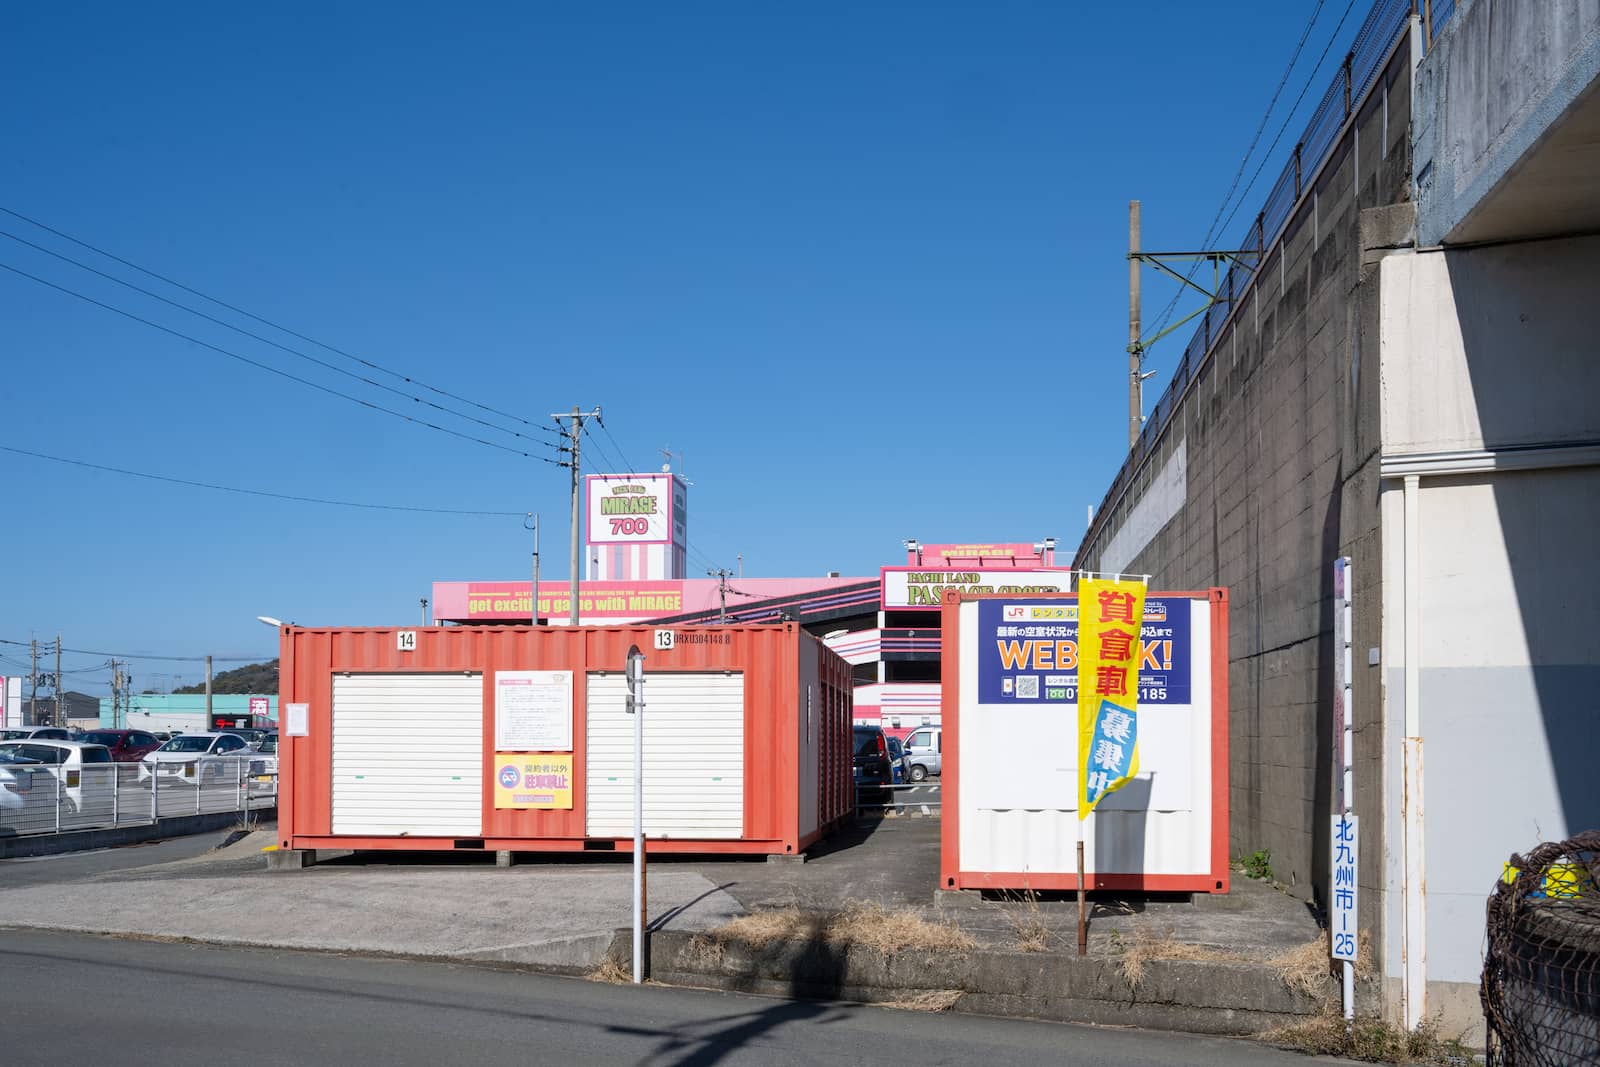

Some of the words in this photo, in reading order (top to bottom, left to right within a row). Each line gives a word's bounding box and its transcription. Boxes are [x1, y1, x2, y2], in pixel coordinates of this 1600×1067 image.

[601, 496, 657, 515] MIRAGE
[609, 518, 648, 535] 700
[908, 573, 944, 584] PACHI
[946, 573, 980, 583] LAND
[469, 598, 491, 613] get
[595, 597, 626, 611] with
[629, 596, 681, 611] MIRAGE
[1008, 608, 1024, 616] JR
[400, 633, 414, 647] 14
[658, 632, 671, 646] 13
[997, 640, 1078, 670] WEB
